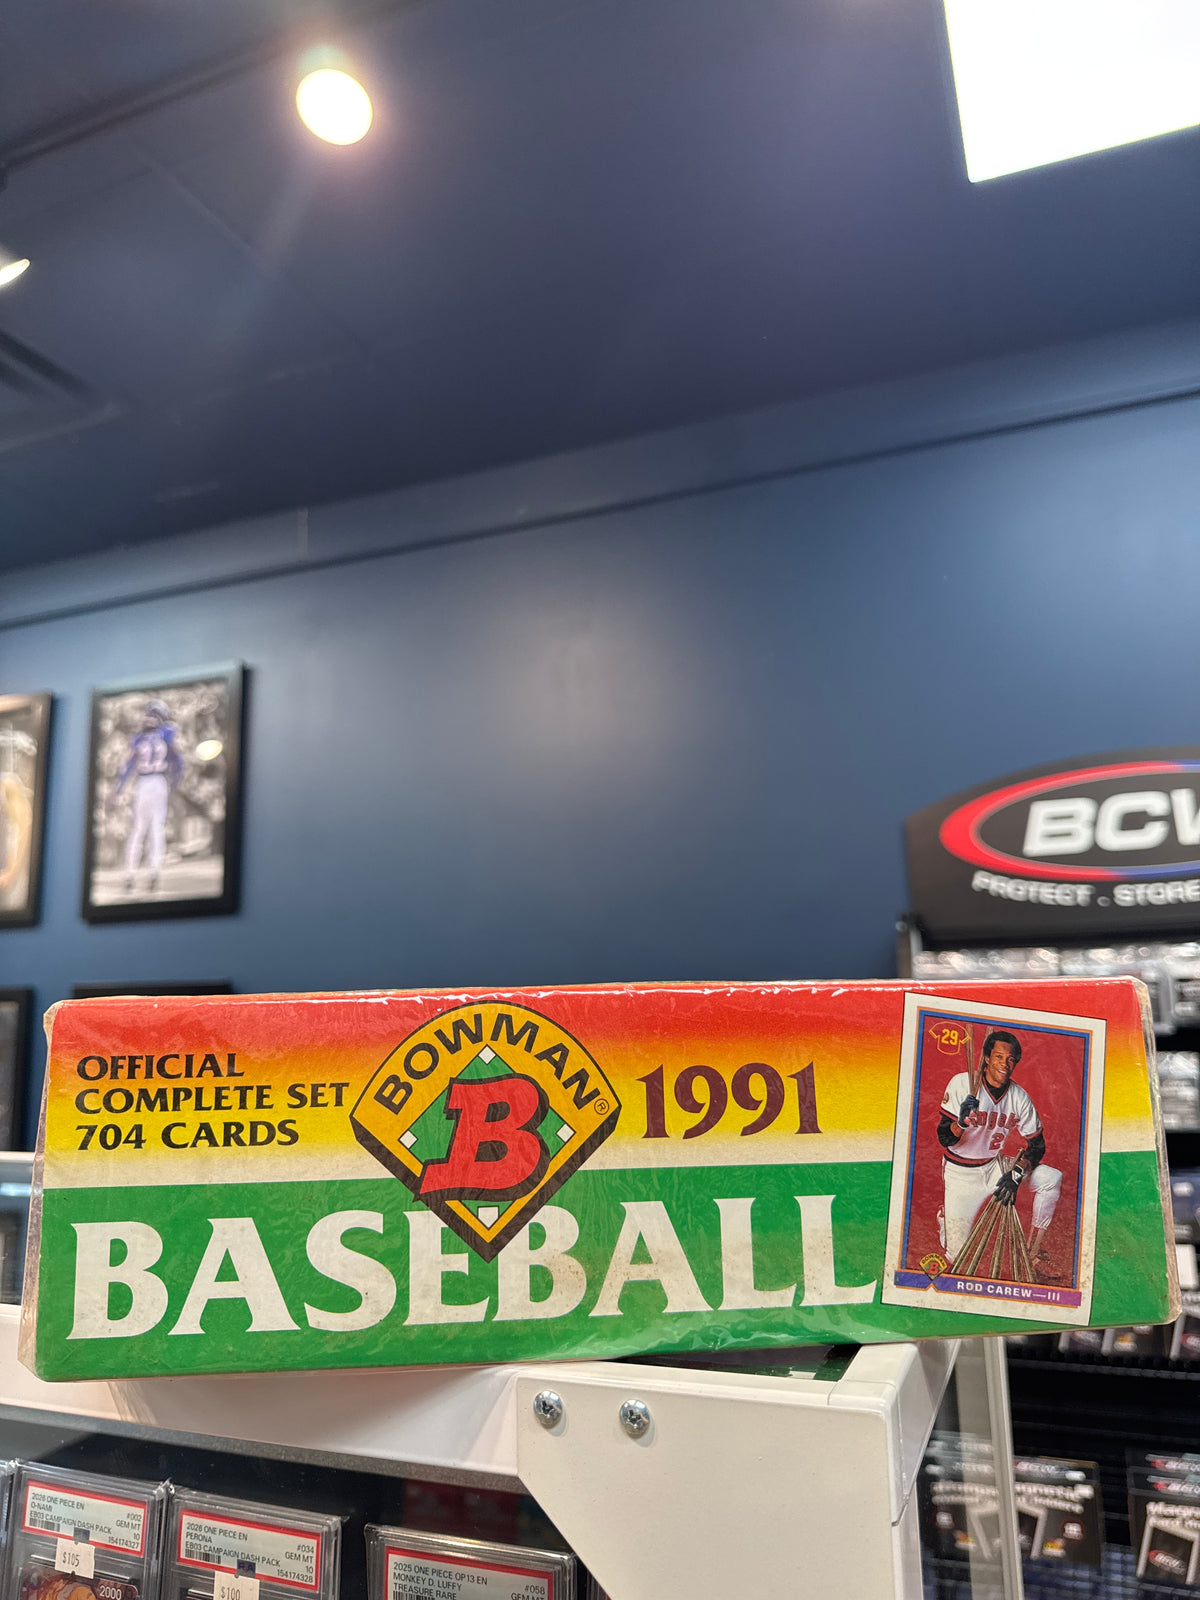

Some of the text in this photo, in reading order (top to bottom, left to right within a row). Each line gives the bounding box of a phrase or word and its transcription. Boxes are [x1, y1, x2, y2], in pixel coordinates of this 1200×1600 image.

[972, 870, 1095, 907] PROTECT
[941, 1028, 959, 1046] 29
[76, 1053, 244, 1081] OFFICIAL
[373, 1012, 601, 1116] BOWMAN
[75, 1082, 349, 1115] COMPLETE SET
[637, 1061, 823, 1139] 1991
[76, 1119, 299, 1151] 704 CARDS
[66, 1194, 876, 1340] BASEBALL
[956, 1281, 983, 1292] ROD
[46, 1496, 58, 1504] ONE
[60, 1498, 76, 1508] PIECE
[76, 1501, 85, 1510] EN
[45, 1513, 76, 1526] CAMPAIGN
[77, 1520, 95, 1531] DASH
[95, 1524, 112, 1534] PACK
[115, 1519, 142, 1531] GEM MT
[133, 1532, 140, 1541] 10
[185, 1532, 213, 1543] PERONA
[203, 1525, 217, 1535] ONE
[218, 1528, 237, 1539] PIECE
[238, 1532, 248, 1541] EN
[185, 1541, 280, 1567] EB03 CAMPAIGN DASH PACK
[296, 1544, 314, 1554] #034
[62, 1551, 80, 1567] $105
[285, 1551, 314, 1564] GEM MT
[277, 1569, 314, 1583] 154174328
[305, 1565, 314, 1574] 10
[393, 1562, 412, 1573] 2025
[413, 1565, 429, 1575] ONE
[431, 1568, 453, 1580] PIECE
[476, 1576, 488, 1586] EN
[393, 1572, 426, 1585] MONKEY
[437, 1581, 462, 1592] LUFFY
[524, 1585, 546, 1595] #058
[100, 1585, 122, 1600] 2000
[220, 1586, 241, 1600] $100
[393, 1583, 457, 1600] TREASURE RARE
